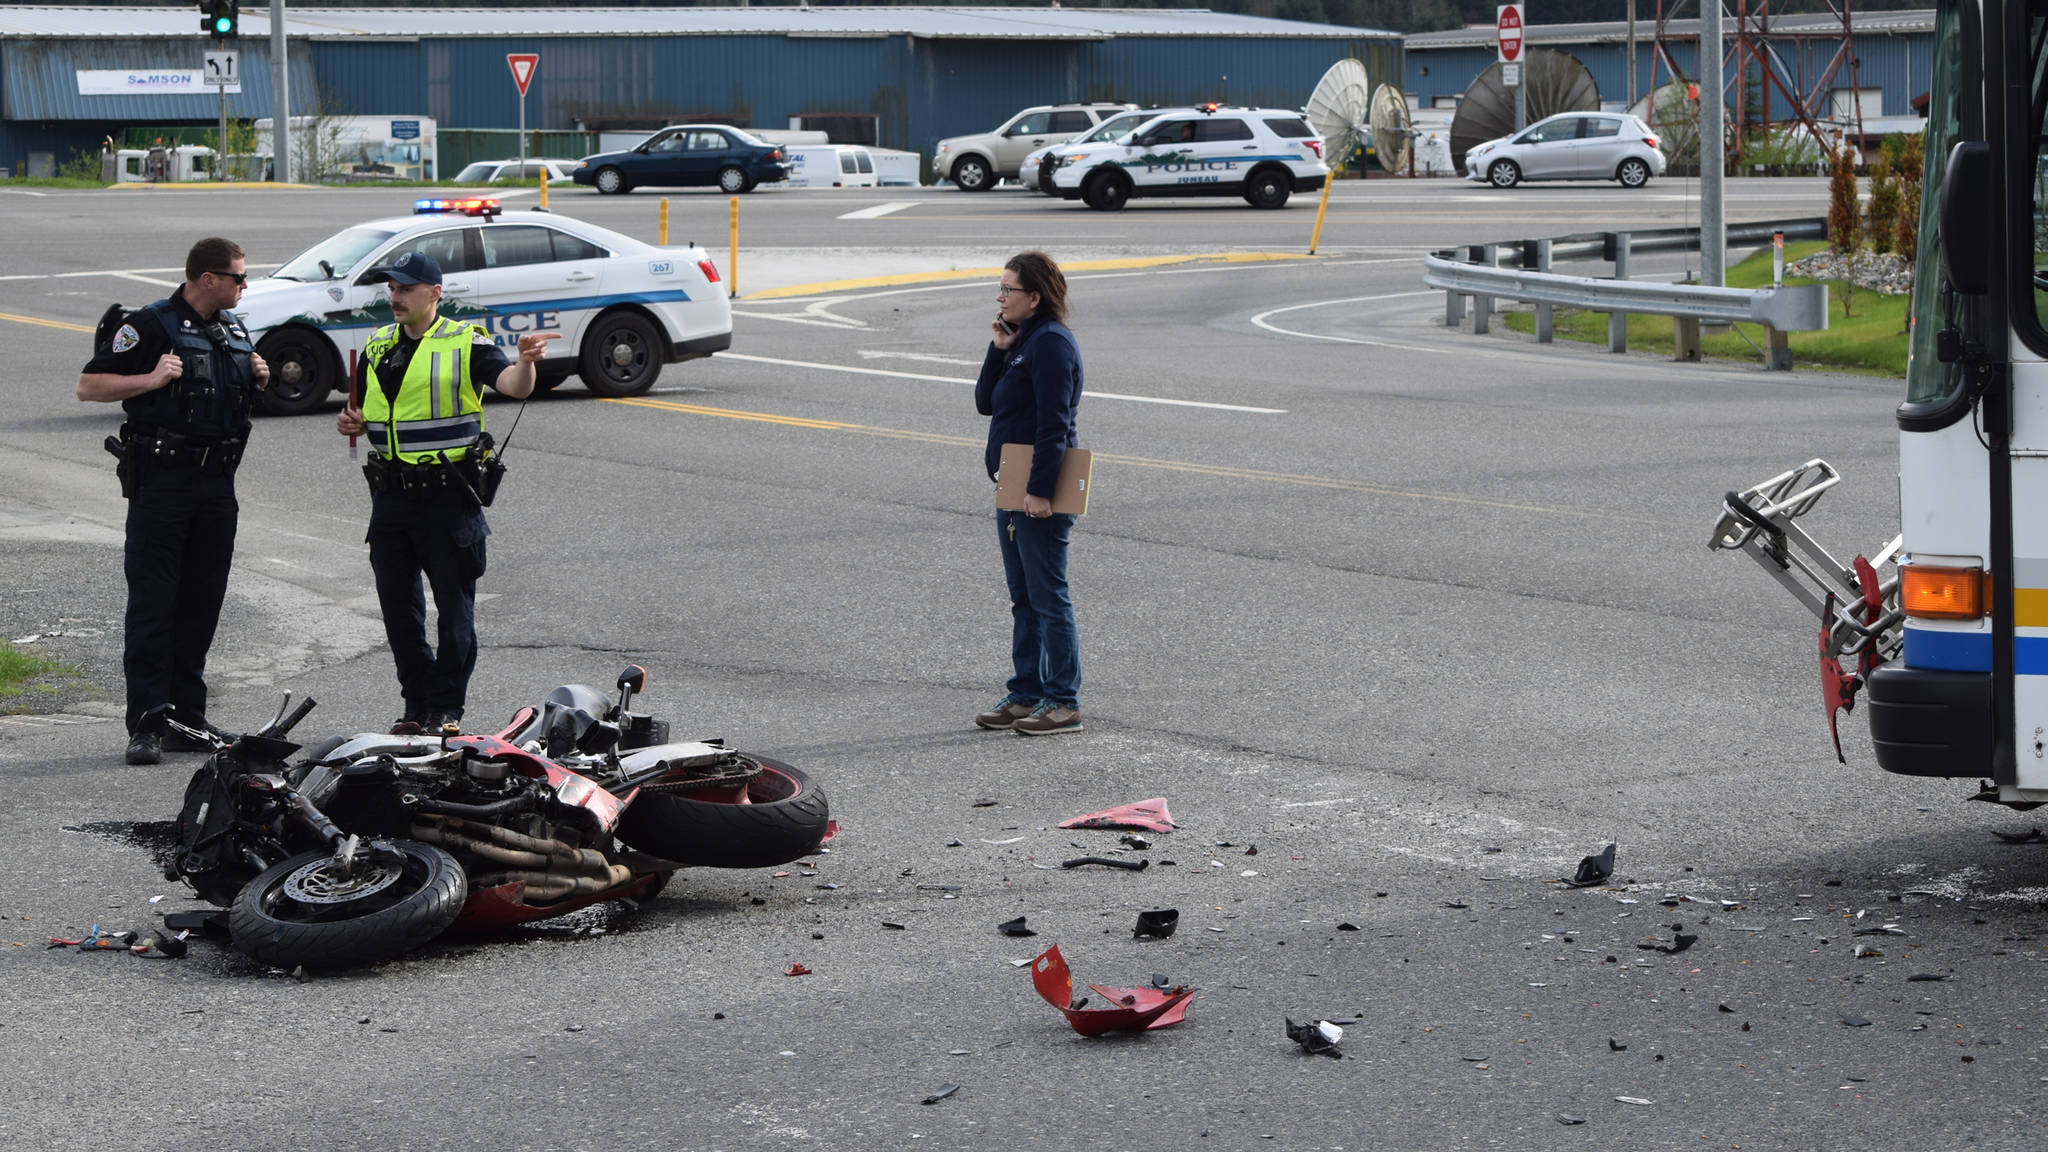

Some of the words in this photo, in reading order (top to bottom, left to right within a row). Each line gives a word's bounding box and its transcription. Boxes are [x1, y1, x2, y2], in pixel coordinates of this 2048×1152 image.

[1146, 160, 1238, 173] POLICE
[1176, 175, 1219, 184] JUNEAU
[652, 263, 670, 272] 267
[484, 308, 561, 335] ICE
